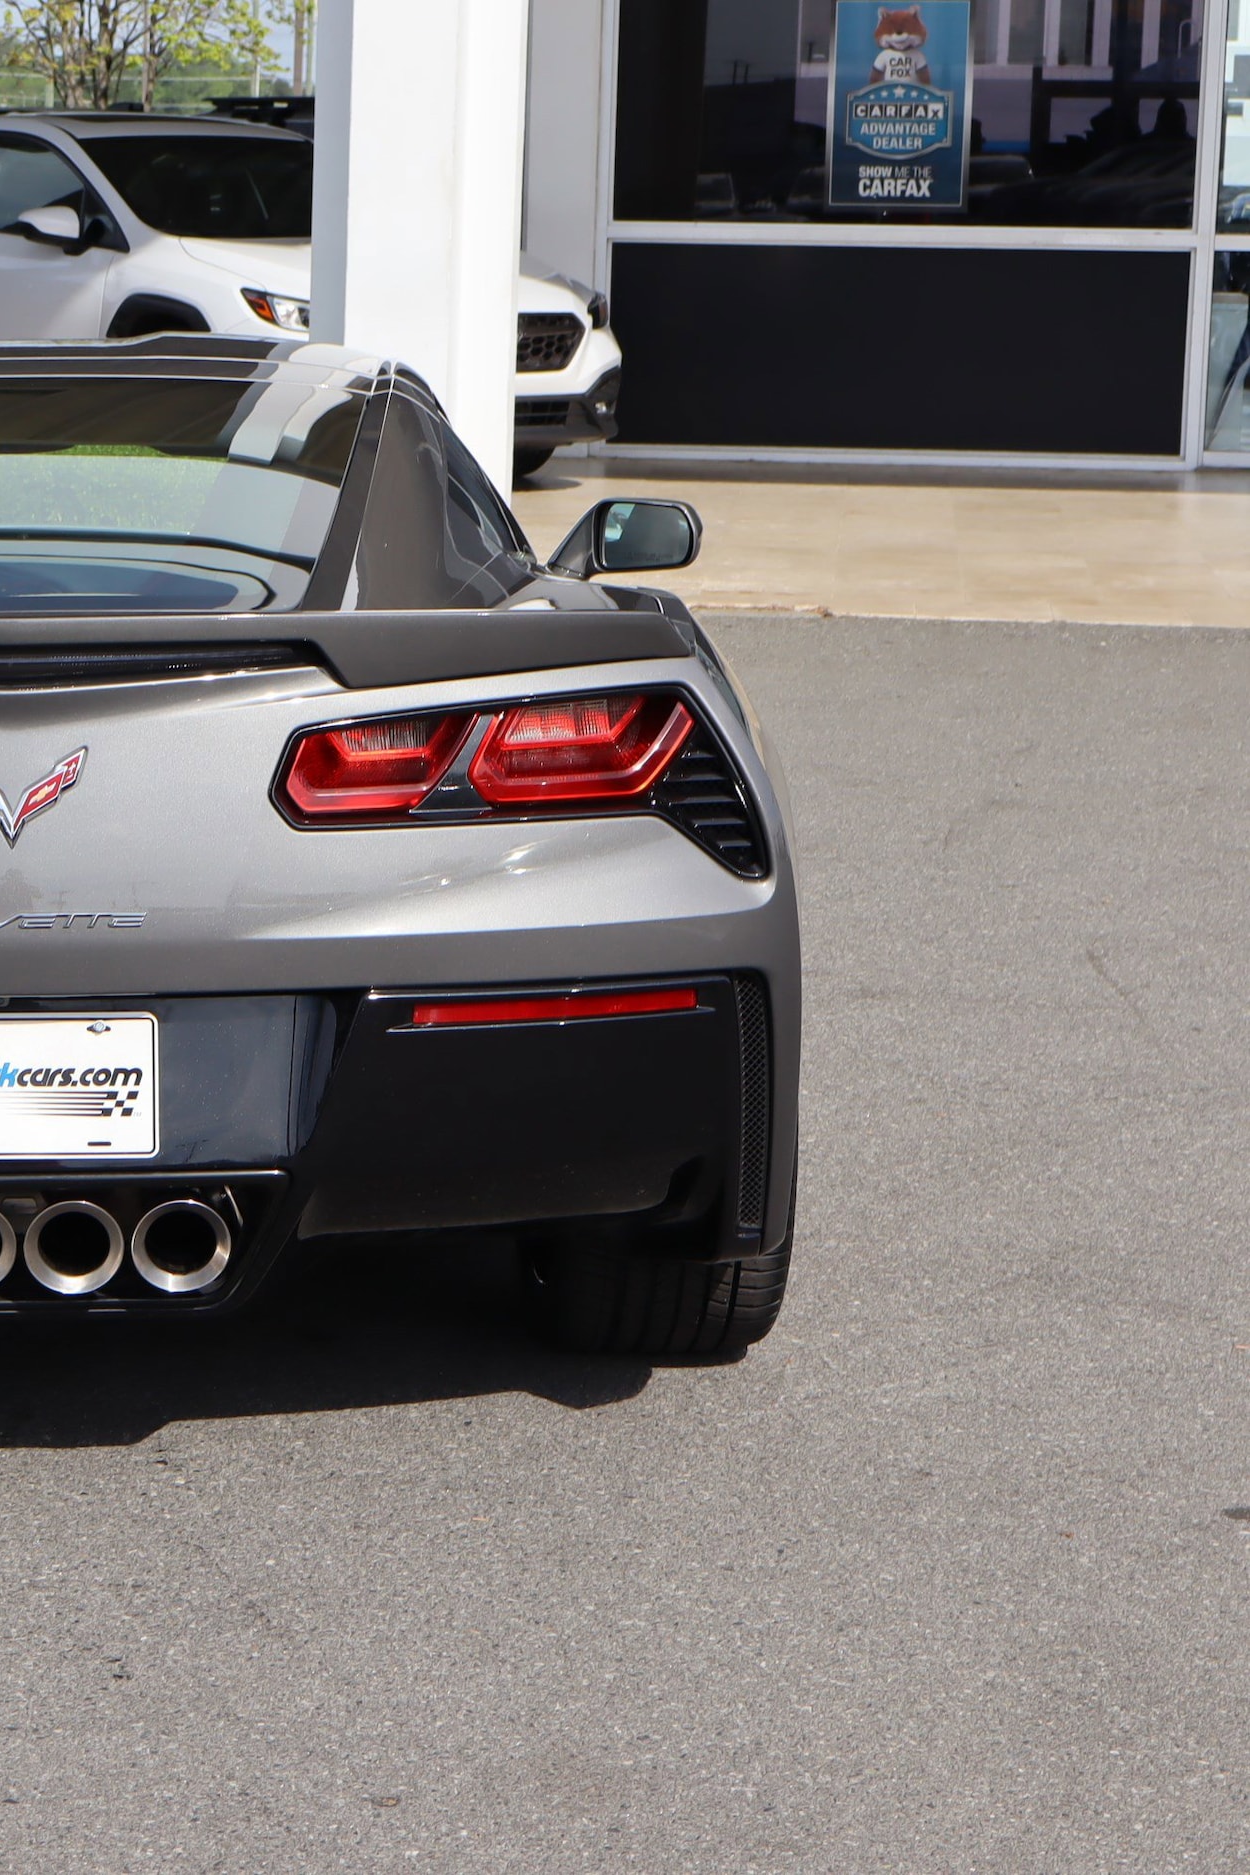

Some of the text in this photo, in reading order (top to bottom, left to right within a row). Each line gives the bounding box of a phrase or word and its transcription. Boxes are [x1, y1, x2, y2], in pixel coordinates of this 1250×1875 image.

[889, 57, 912, 67] CAR
[890, 68, 911, 78] FOX
[854, 103, 943, 119] CARFAX
[860, 122, 936, 135] ADVANTAGE
[873, 137, 922, 149] DEALER
[858, 166, 932, 178] SHOW ME THE
[858, 179, 931, 197] CARFAX
